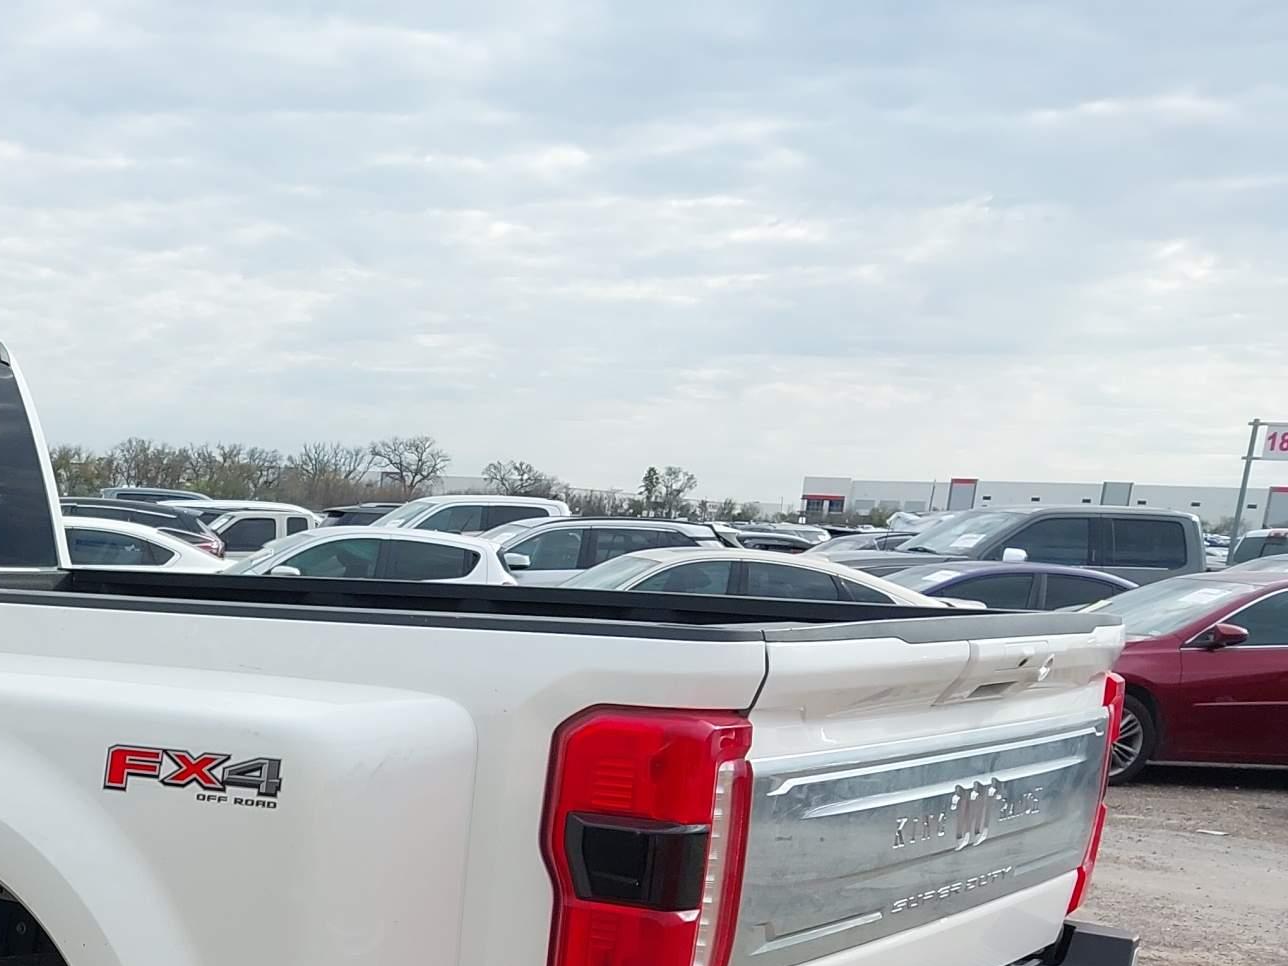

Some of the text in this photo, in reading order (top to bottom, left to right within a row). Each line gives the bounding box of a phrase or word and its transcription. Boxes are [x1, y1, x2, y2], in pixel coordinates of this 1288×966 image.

[102, 743, 282, 798] FX4
[196, 793, 277, 809] OFF ROAD
[891, 866, 1013, 913] SUPER DUTY
